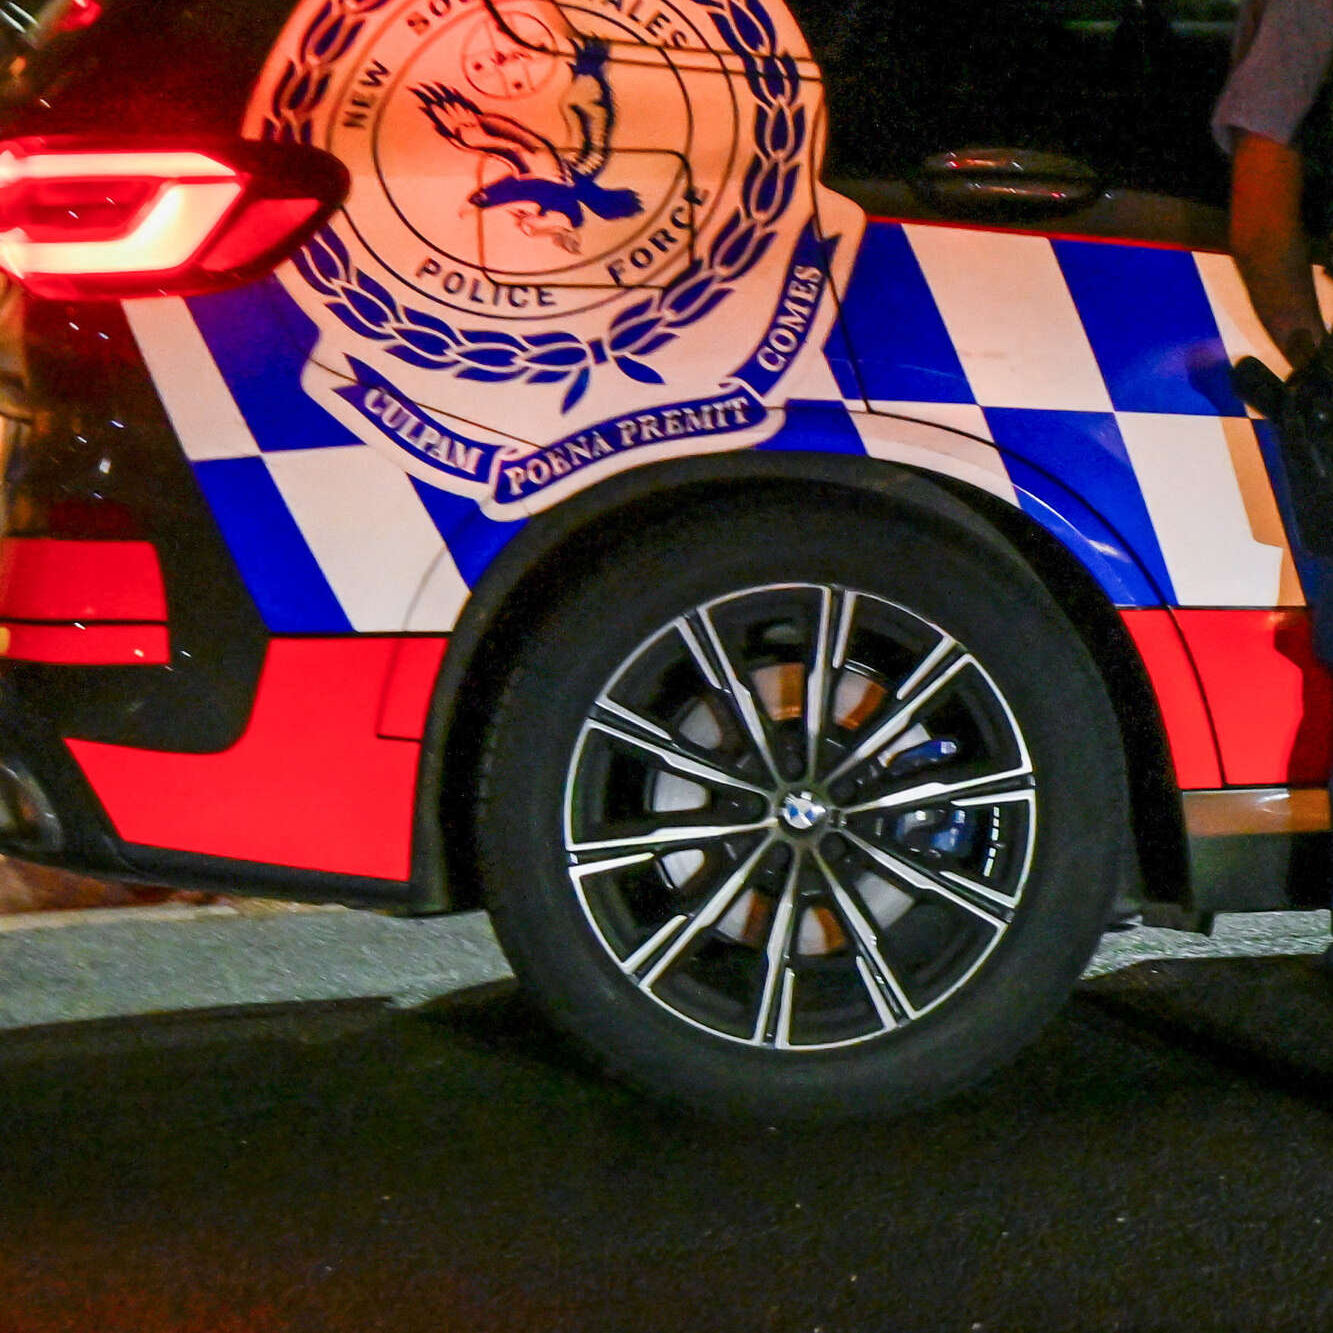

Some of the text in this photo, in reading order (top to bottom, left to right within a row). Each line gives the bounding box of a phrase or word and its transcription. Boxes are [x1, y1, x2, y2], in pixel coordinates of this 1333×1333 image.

[343, 59, 389, 128] NEW
[416, 186, 712, 308] POLICE FORCE
[362, 386, 485, 476] CULPAM
[617, 395, 751, 448] PREMIT
[757, 264, 823, 374] COMES
